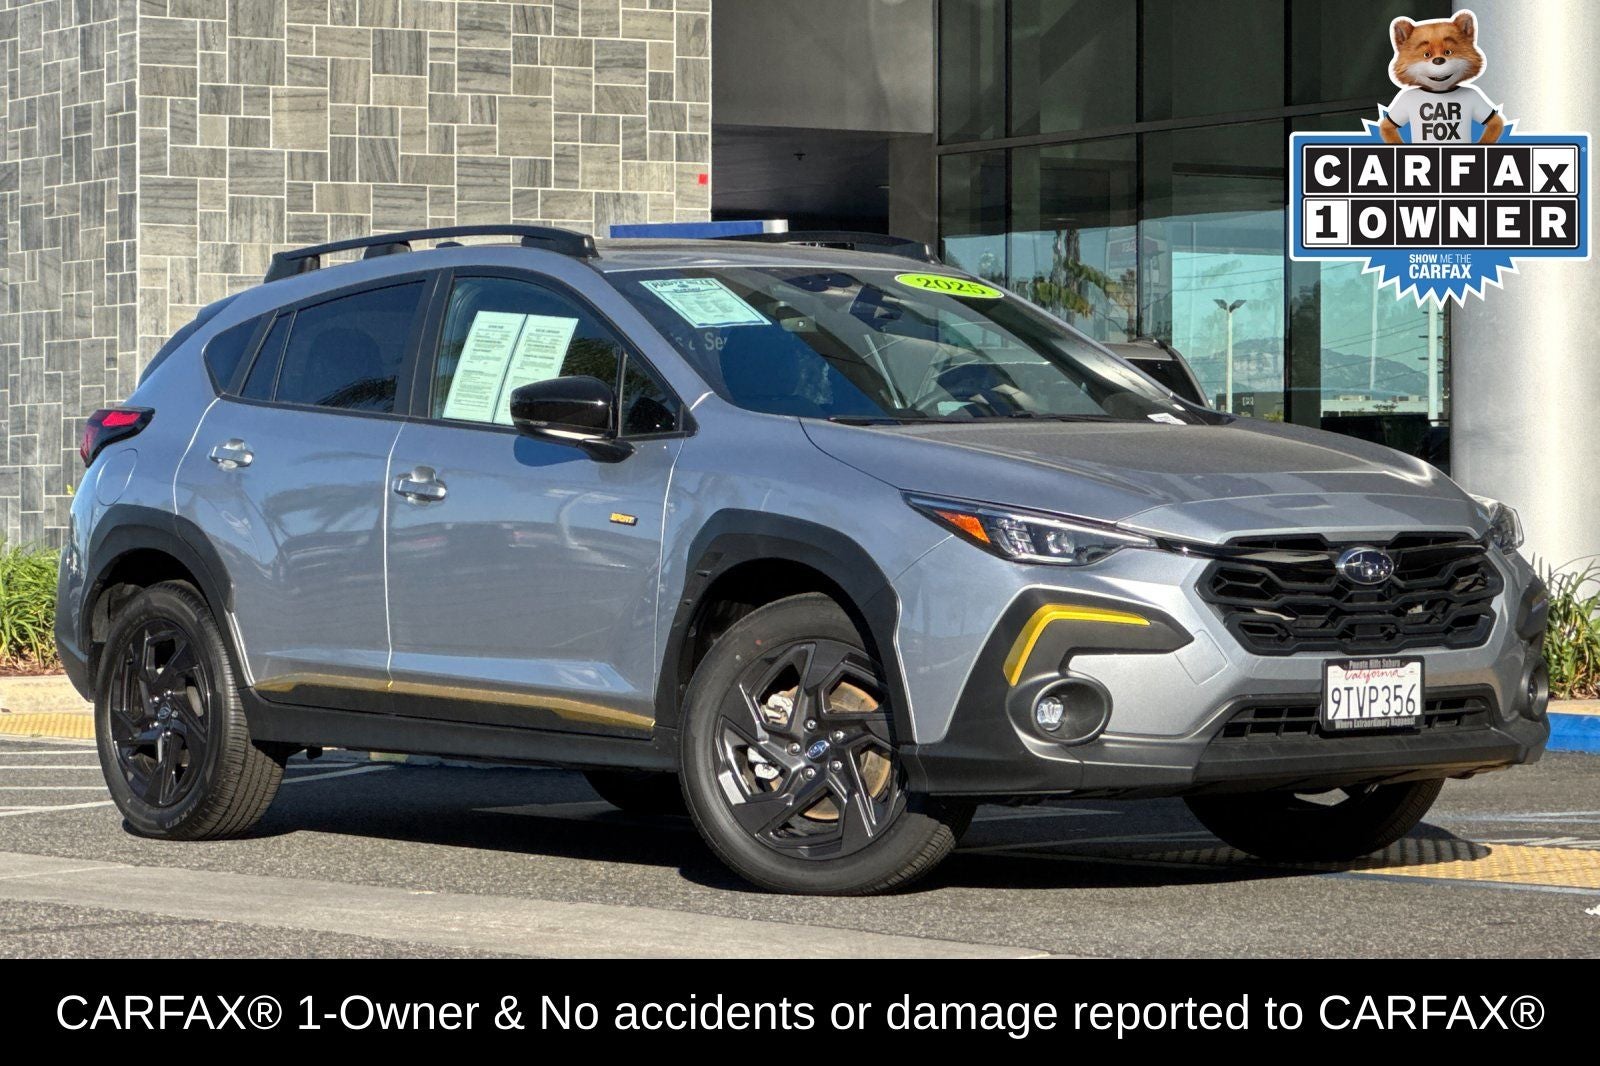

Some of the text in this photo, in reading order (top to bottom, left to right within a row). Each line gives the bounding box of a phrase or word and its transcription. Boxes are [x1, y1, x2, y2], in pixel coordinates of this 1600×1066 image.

[916, 278, 986, 295] 2025
[1344, 668, 1405, 684] California
[1331, 683, 1417, 719] 9TVP356
